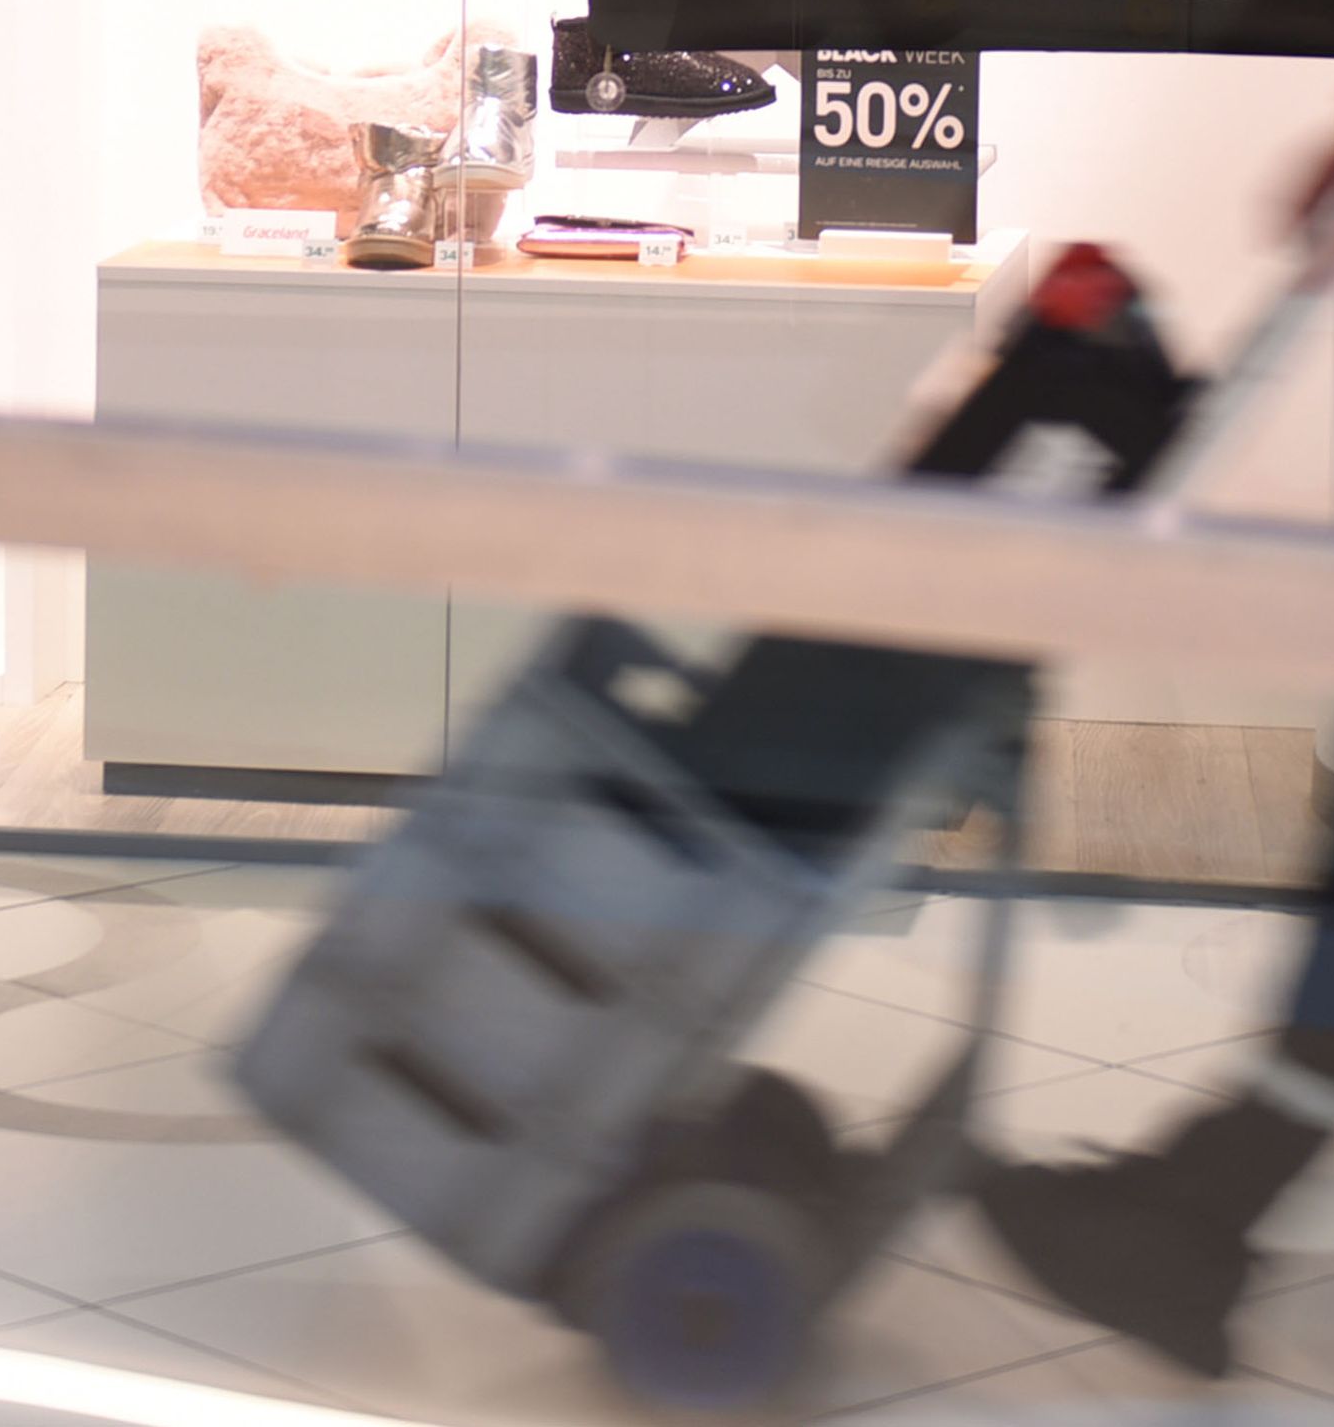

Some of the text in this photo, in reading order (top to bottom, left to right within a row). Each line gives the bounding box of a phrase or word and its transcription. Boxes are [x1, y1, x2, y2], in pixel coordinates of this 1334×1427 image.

[817, 68, 852, 80] BIS ZU
[814, 156, 963, 171] AUF EINE RIESIGE AUSWAHL
